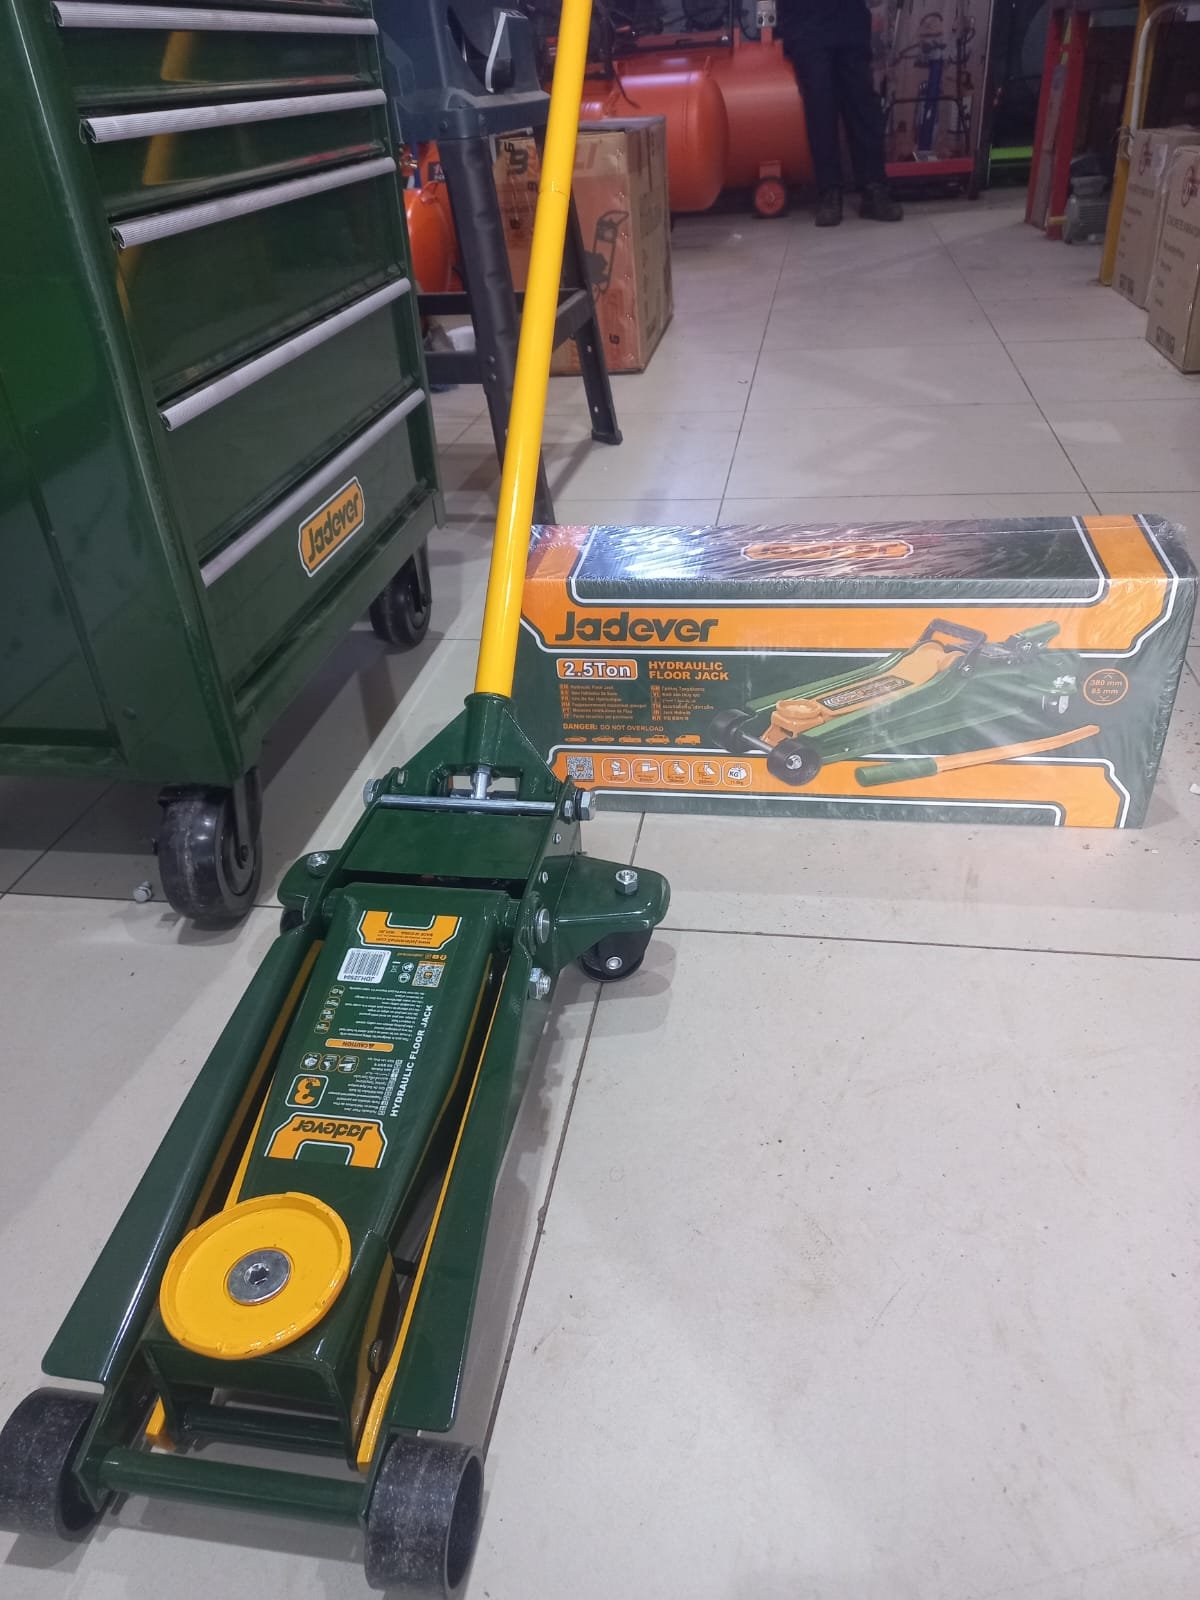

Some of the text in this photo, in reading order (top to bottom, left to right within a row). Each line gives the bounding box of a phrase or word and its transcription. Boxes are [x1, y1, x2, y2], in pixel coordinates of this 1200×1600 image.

[308, 493, 359, 563] Jadever
[555, 611, 719, 642] Jadever
[564, 661, 631, 678] 2.5Ton
[648, 660, 724, 671] HYDRAULIC
[648, 671, 729, 681] FLOOR JACK
[562, 722, 599, 730] DANGER:
[729, 770, 740, 778] KG
[342, 1041, 370, 1049] CAUTION
[390, 1004, 434, 1117] HYDRAULIC FLOOR JACK
[294, 1077, 321, 1105] 3
[292, 1119, 373, 1142] Jadever
